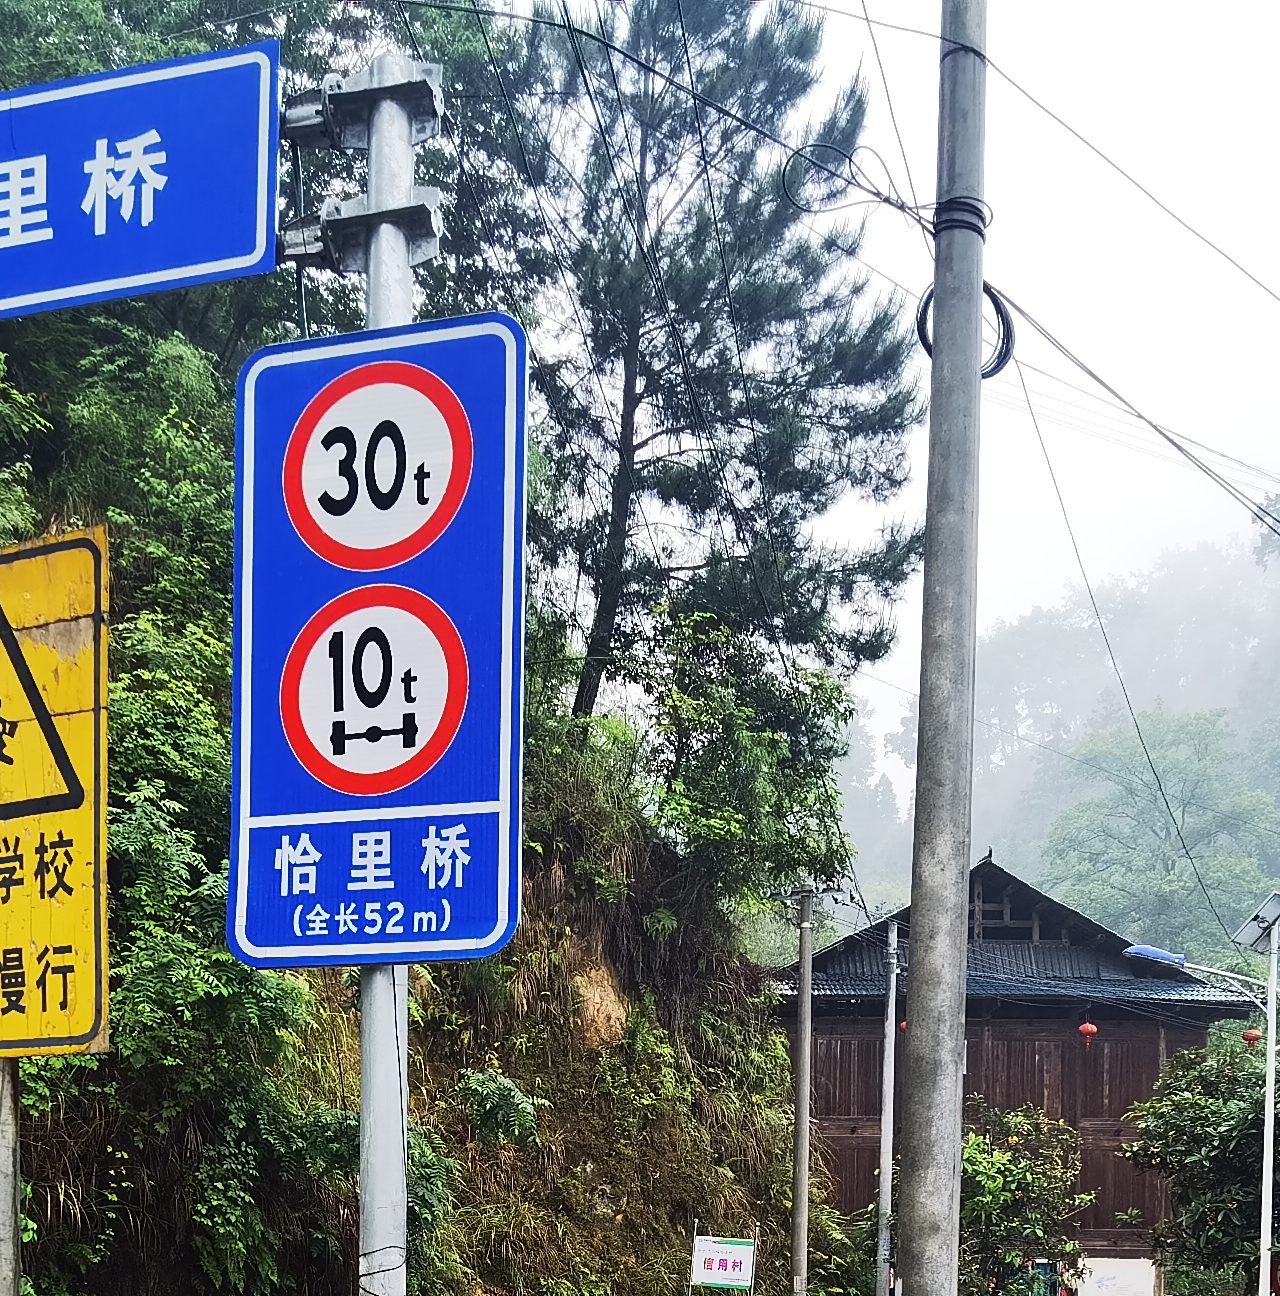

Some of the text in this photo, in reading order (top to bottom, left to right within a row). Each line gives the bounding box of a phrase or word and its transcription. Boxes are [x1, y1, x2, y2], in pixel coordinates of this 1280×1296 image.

[317, 419, 431, 517] 30t
[328, 626, 418, 713] 10t
[274, 823, 471, 897] 恰里桥
[703, 1257, 743, 1273] 信用村
